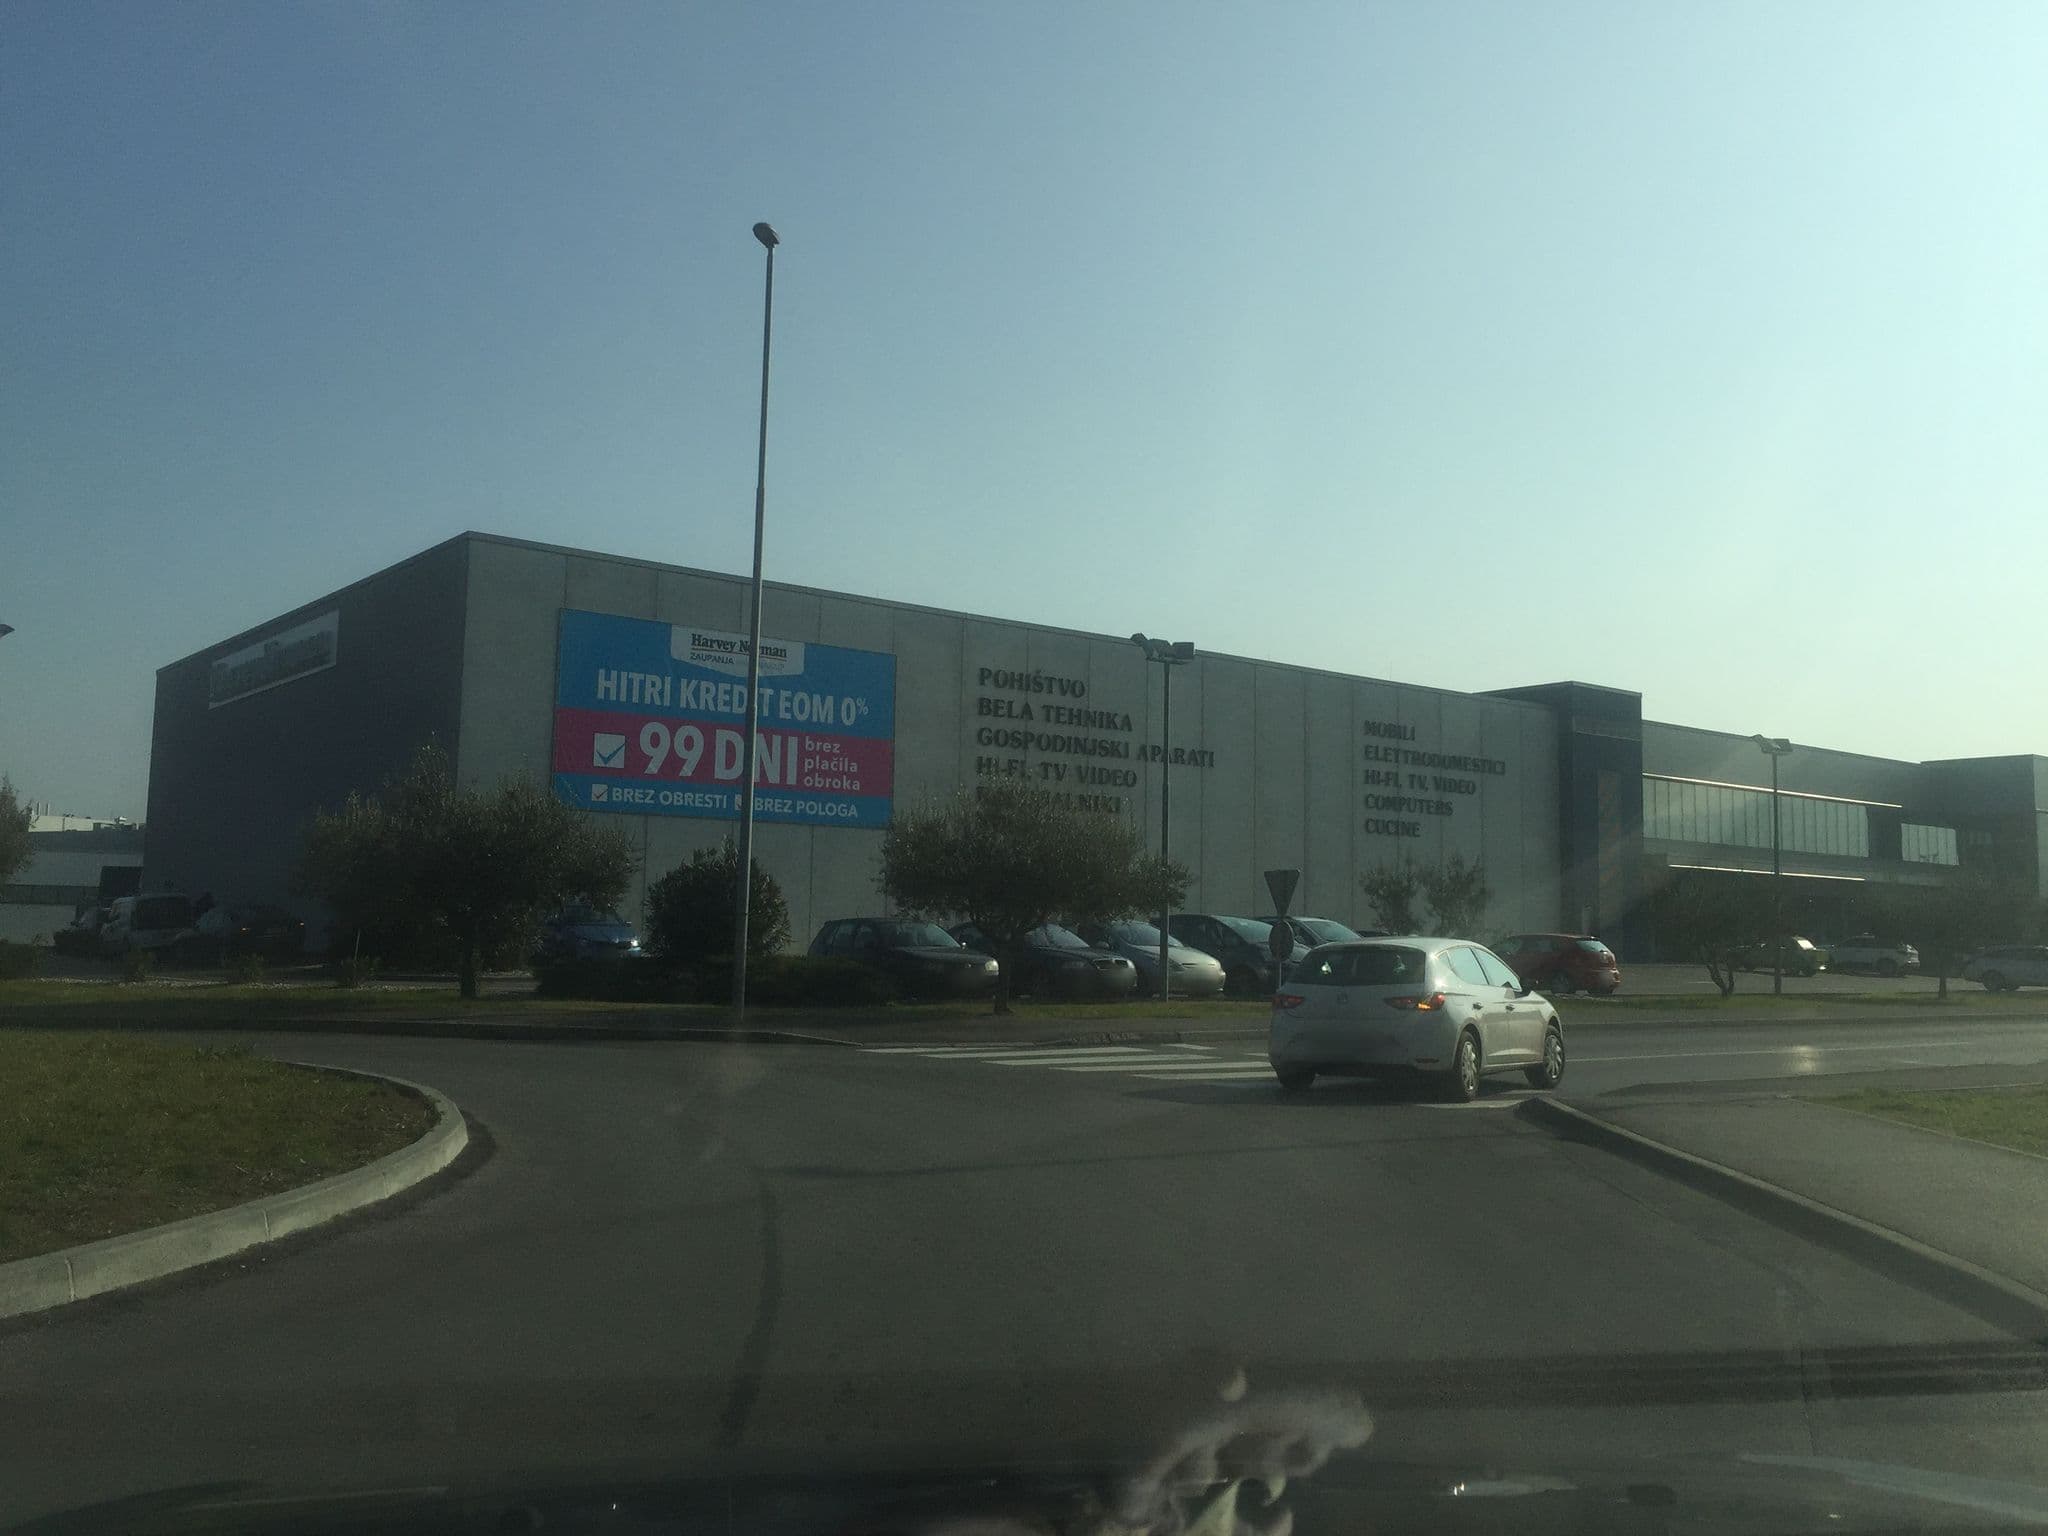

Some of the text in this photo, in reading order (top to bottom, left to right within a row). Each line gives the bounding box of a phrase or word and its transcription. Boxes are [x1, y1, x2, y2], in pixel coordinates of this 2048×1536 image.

[691, 633, 787, 658] Harvey Nman
[978, 667, 1086, 698] POHIŠTVO
[597, 669, 869, 726] HITRI KREDT EOM 0%
[977, 697, 1133, 732] BELA TEHNIKA
[639, 721, 798, 785] 99 DNI
[804, 735, 841, 754] brez
[976, 727, 1215, 769] GOSPODINJSKI APARATI
[804, 754, 858, 773] plačila
[803, 771, 861, 791] obroka
[1075, 765, 1138, 788] VIDEO
[1433, 776, 1476, 795] VIDEO
[612, 786, 859, 819] BREZ OBRESTI BREZ POLOGA
[1365, 793, 1453, 816] COMPUTERS
[1365, 818, 1421, 837] CUCINE
